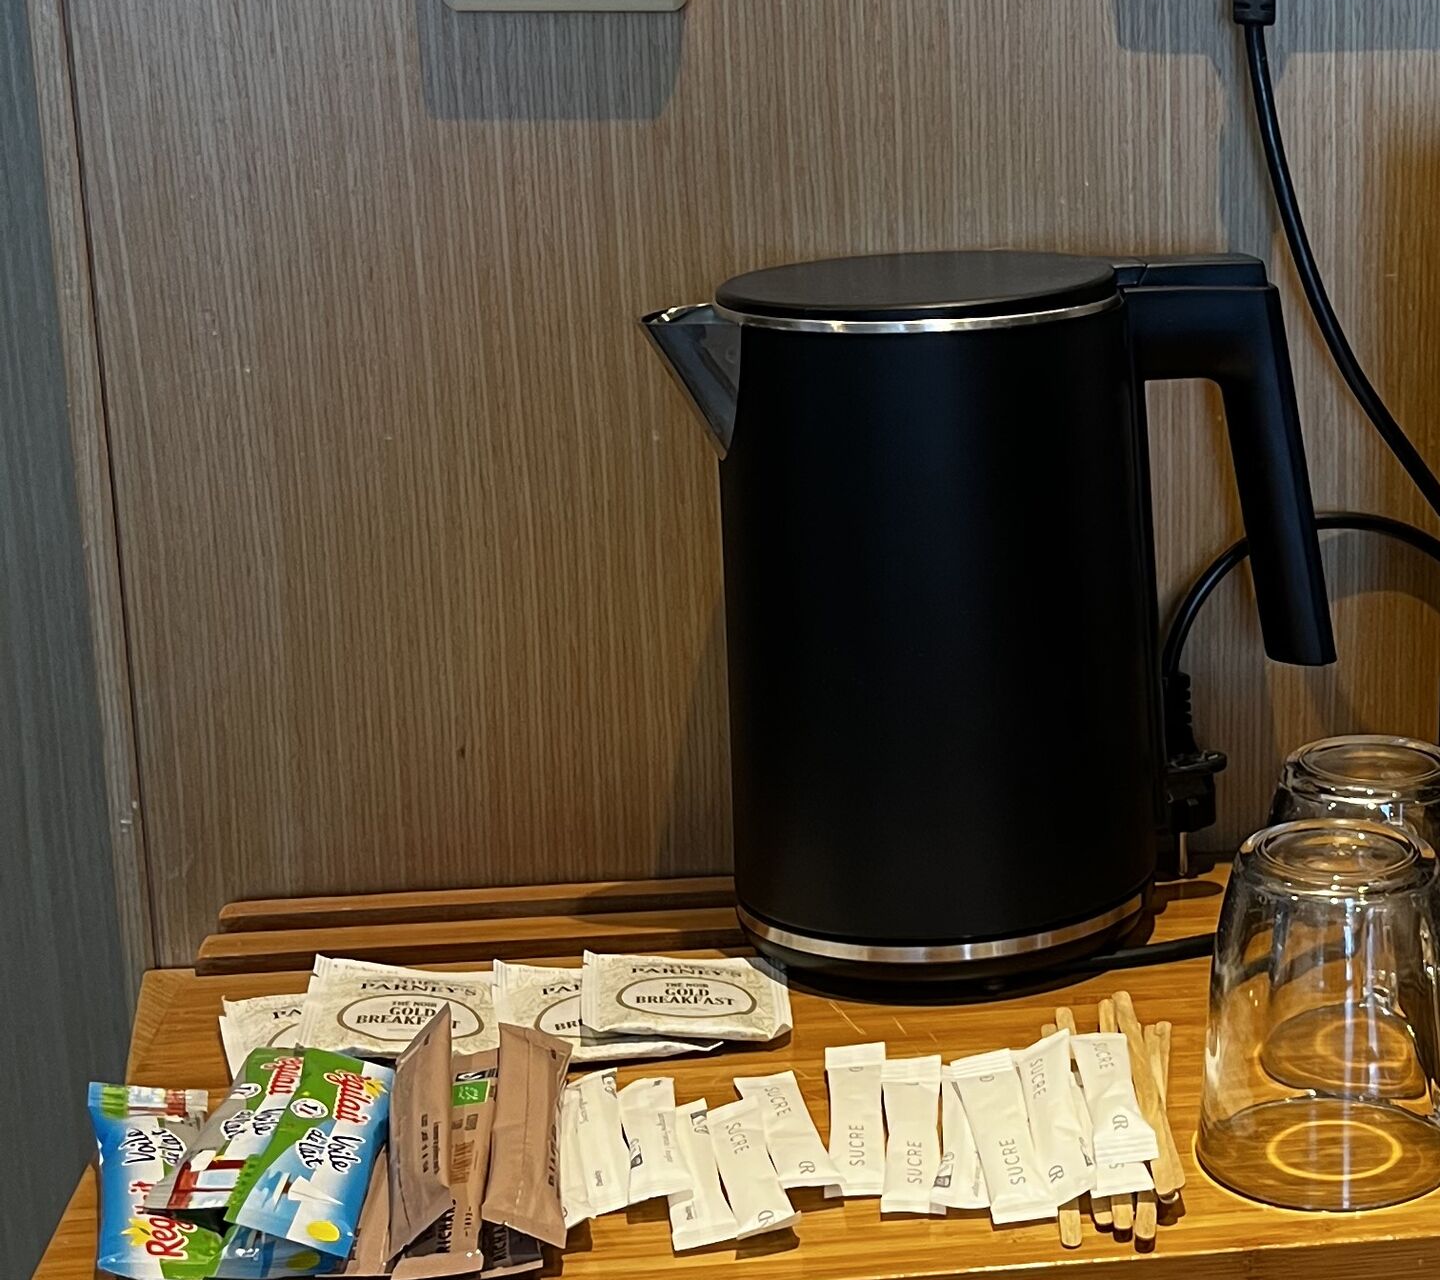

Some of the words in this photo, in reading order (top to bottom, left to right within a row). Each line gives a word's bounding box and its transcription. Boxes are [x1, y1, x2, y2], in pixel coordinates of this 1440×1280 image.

[636, 995, 735, 1007] BREAKFAST
[664, 988, 710, 997] GOLD
[355, 1014, 461, 1030] BREAKFT
[389, 1007, 437, 1017] GOLD
[1092, 1042, 1115, 1070] SUCRE
[1029, 1057, 1047, 1100] SUCRE
[764, 1086, 793, 1117] SUCRE
[122, 1128, 156, 1165] Voile
[328, 1135, 363, 1172] Voile
[725, 1121, 750, 1155] SUCRE
[849, 1124, 865, 1167] SUCRE
[907, 1140, 923, 1185] SUCRE
[999, 1137, 1027, 1186] SUCRE
